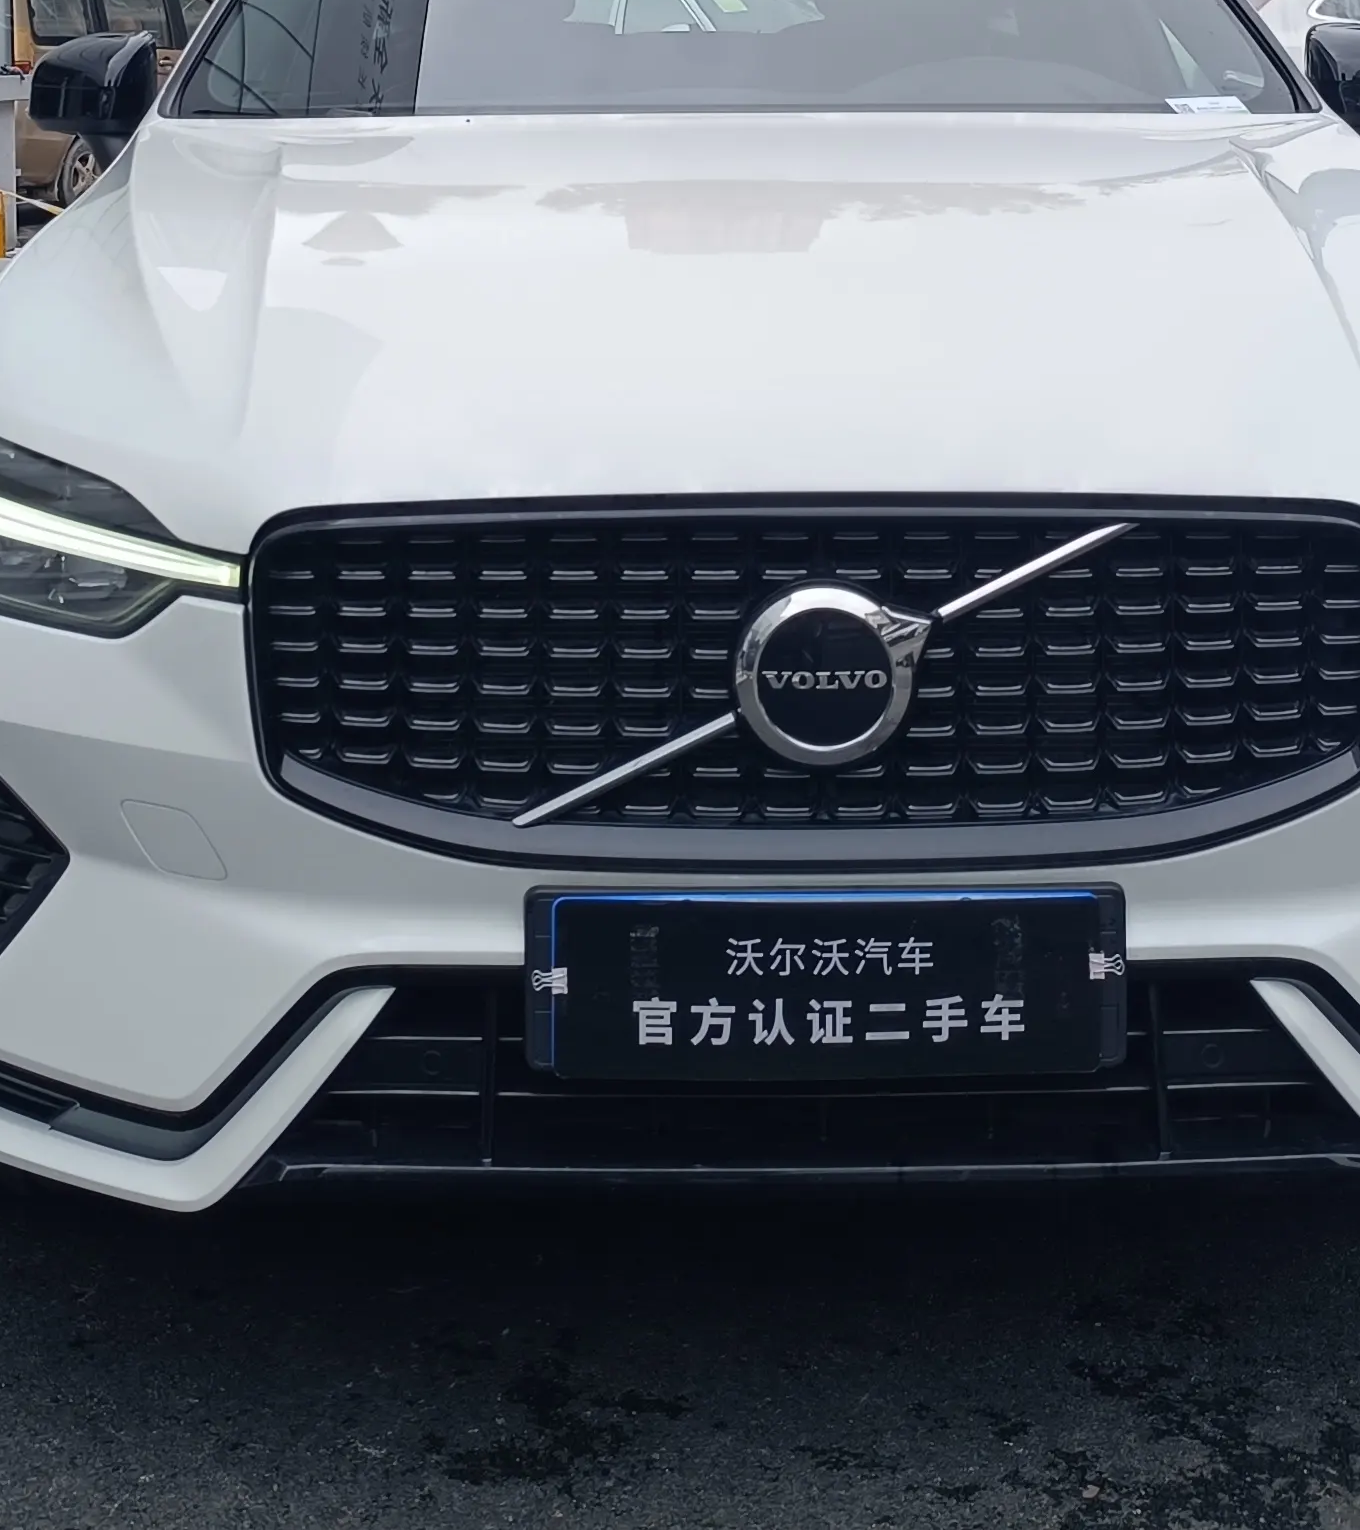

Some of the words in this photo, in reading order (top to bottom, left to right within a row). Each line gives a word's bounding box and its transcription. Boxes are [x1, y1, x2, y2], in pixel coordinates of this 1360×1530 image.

[761, 670, 888, 690] VOLVO
[725, 937, 935, 976] 沃尔沃汽车
[632, 993, 1026, 1046] 官方认证二手车
